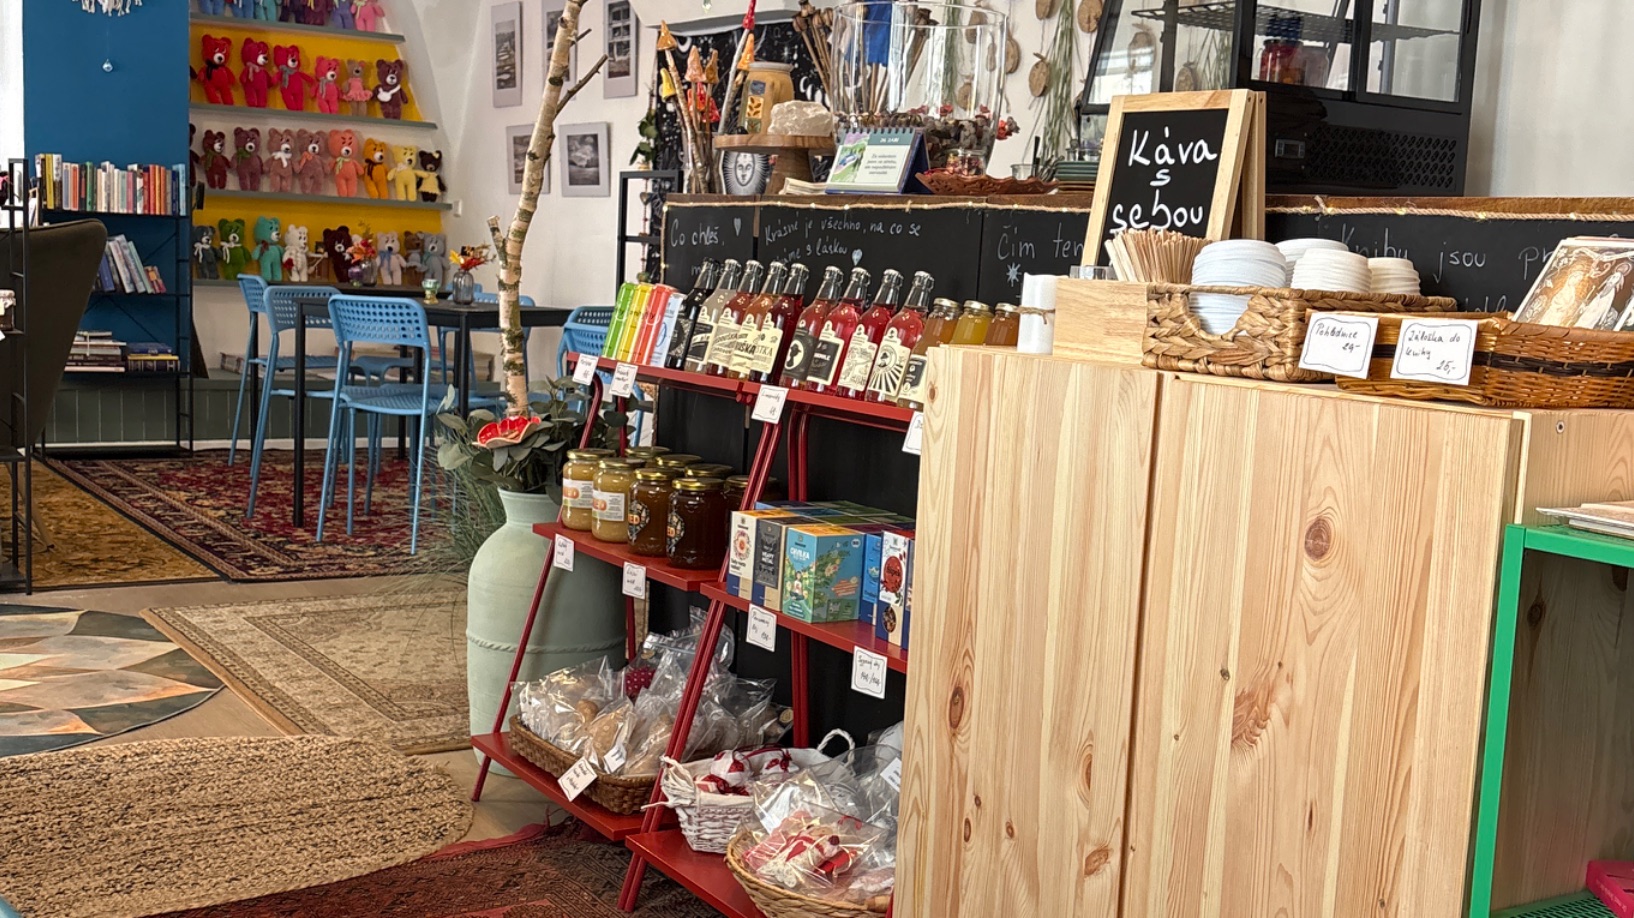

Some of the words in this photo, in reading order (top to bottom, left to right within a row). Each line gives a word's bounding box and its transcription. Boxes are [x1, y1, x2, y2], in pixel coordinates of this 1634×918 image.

[1128, 126, 1218, 167] Káva
[1150, 169, 1171, 187] s
[1109, 189, 1204, 233] sebou
[670, 218, 685, 247] Co
[804, 217, 814, 239] je
[869, 222, 885, 234] na
[890, 223, 902, 235] co
[909, 222, 921, 237] se
[997, 224, 1036, 261] Čím
[1432, 240, 1486, 285] jsou
[1449, 331, 1461, 343] do
